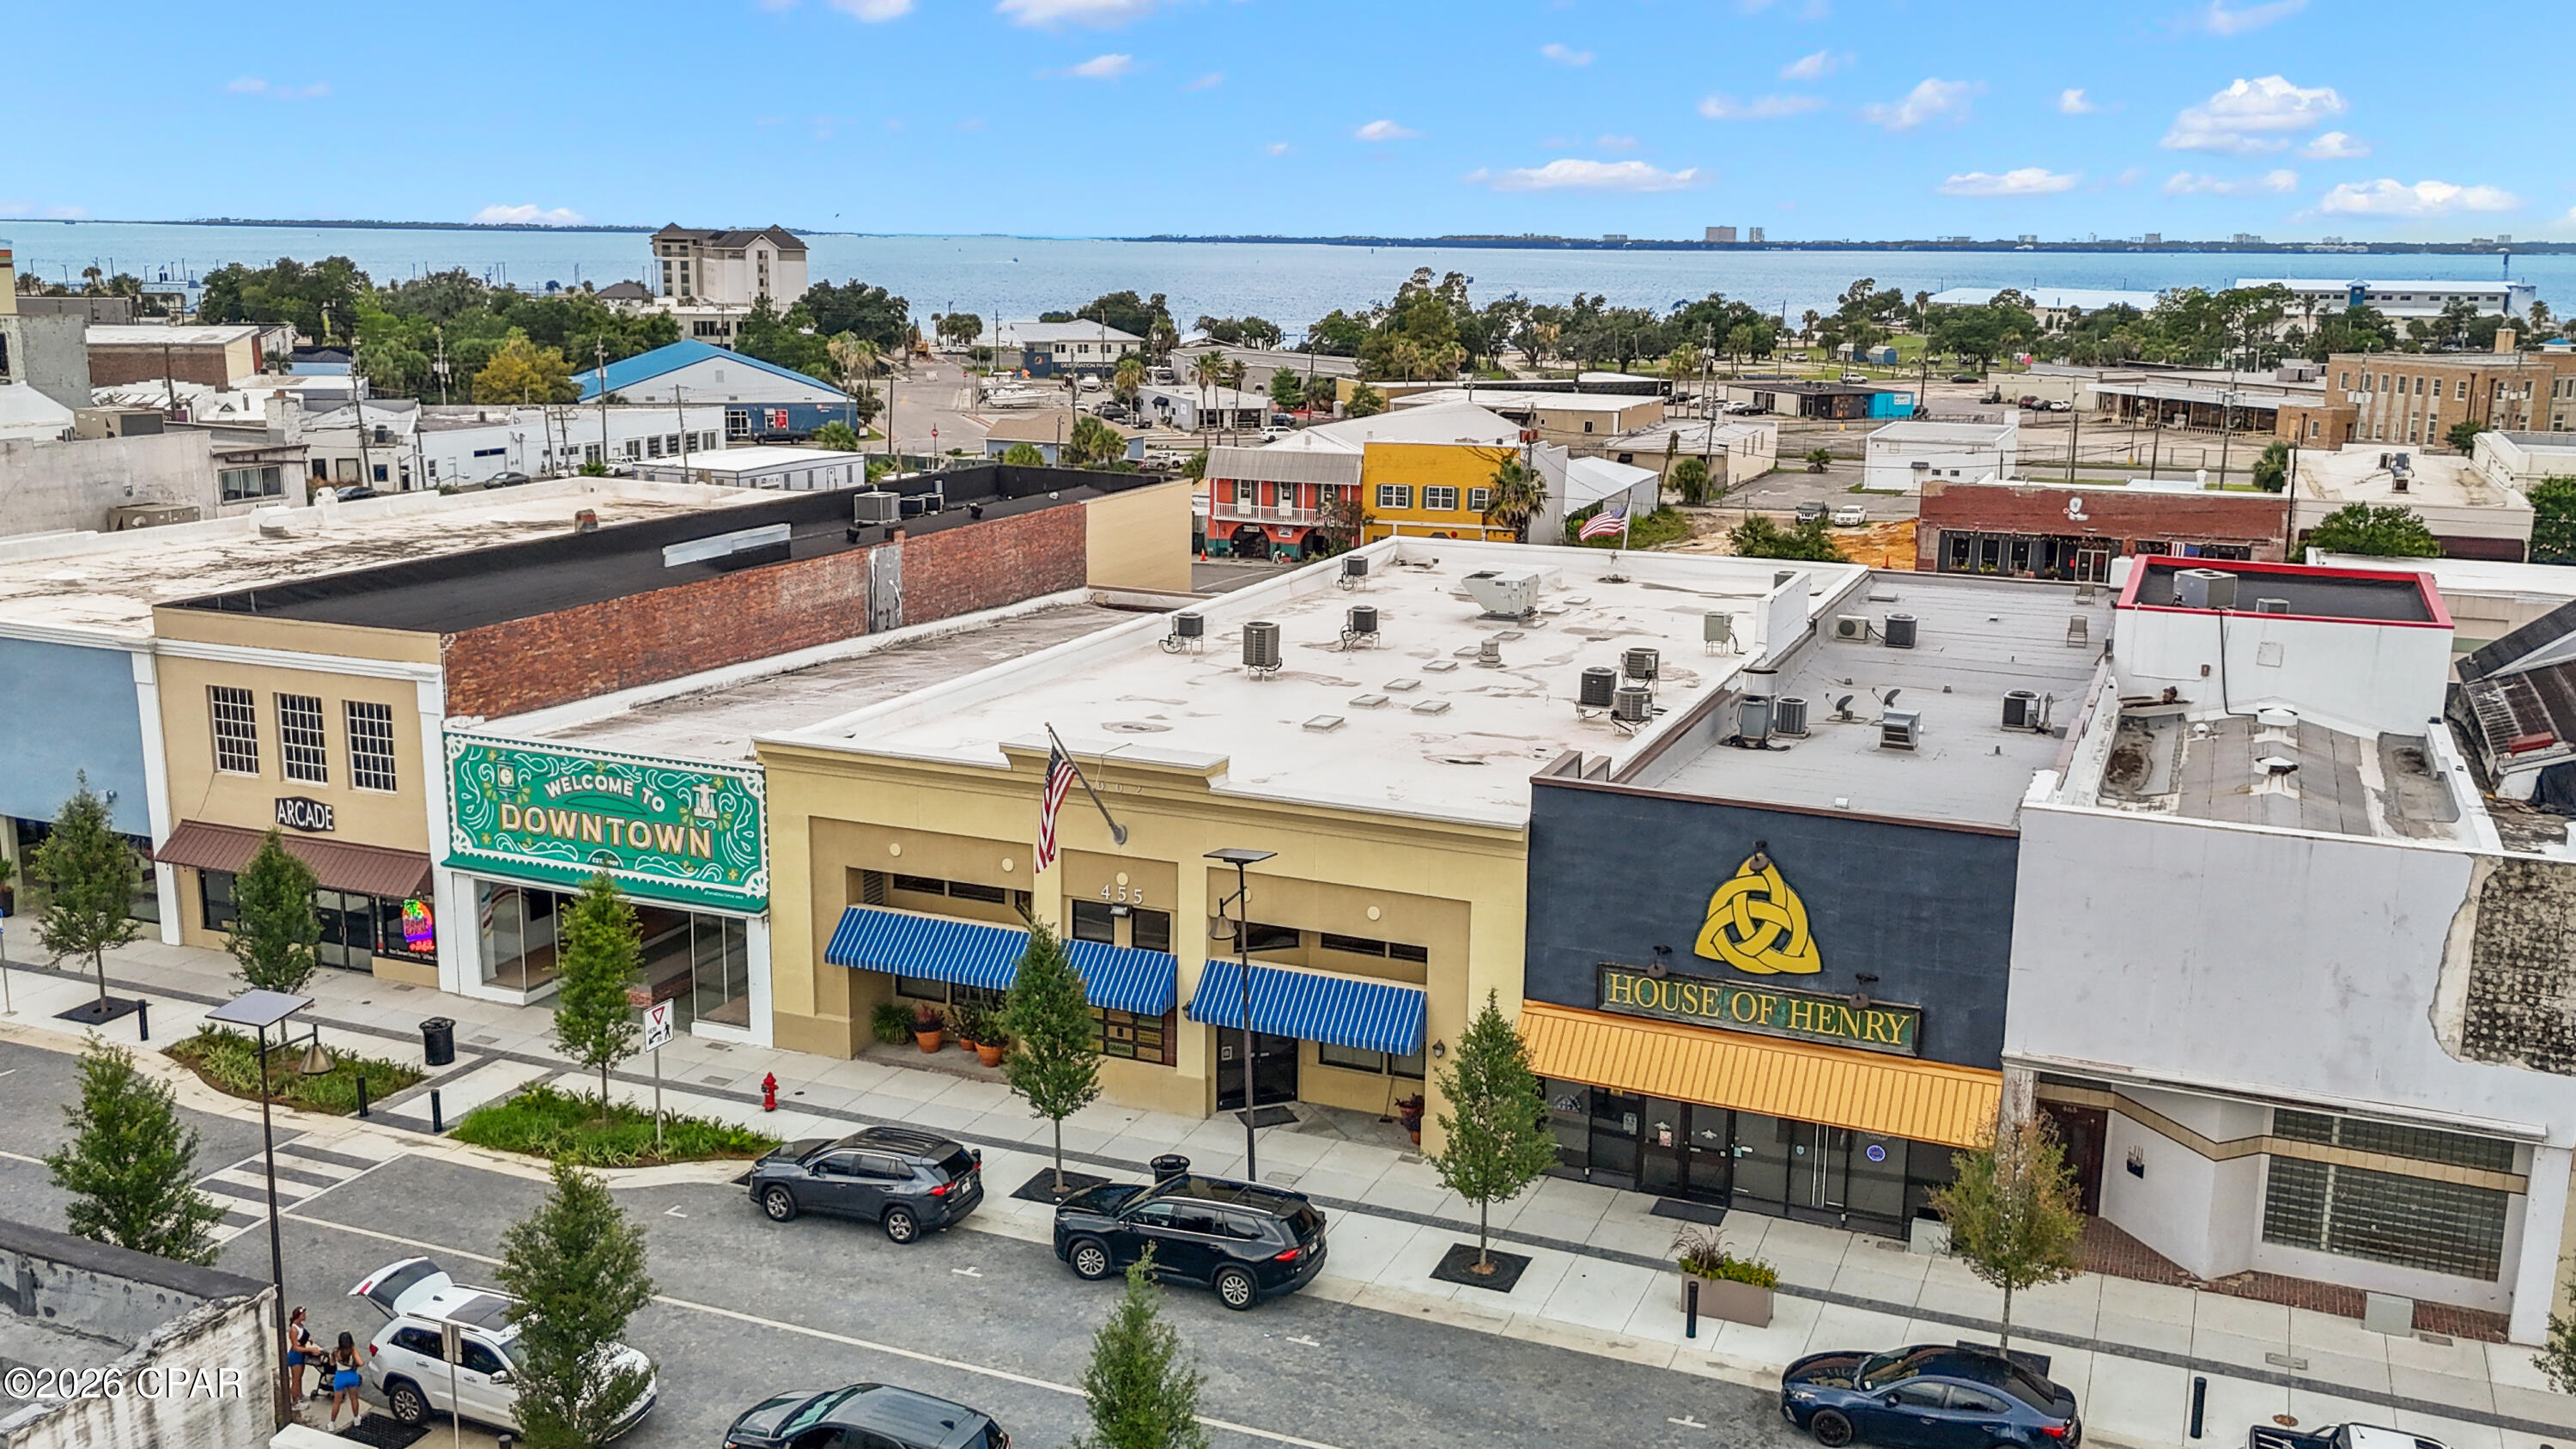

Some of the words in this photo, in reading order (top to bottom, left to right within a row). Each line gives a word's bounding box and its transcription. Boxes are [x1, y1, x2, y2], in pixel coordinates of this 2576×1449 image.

[544, 774, 634, 800] WELCOME
[641, 786, 666, 813] TO
[276, 799, 334, 831] ARCADE
[500, 802, 713, 860] DOWNTOWN
[1100, 885, 1143, 904] 455
[1608, 973, 1720, 1017] HOUSE
[1731, 991, 1777, 1025] OF
[1788, 998, 1911, 1045] HENRY
